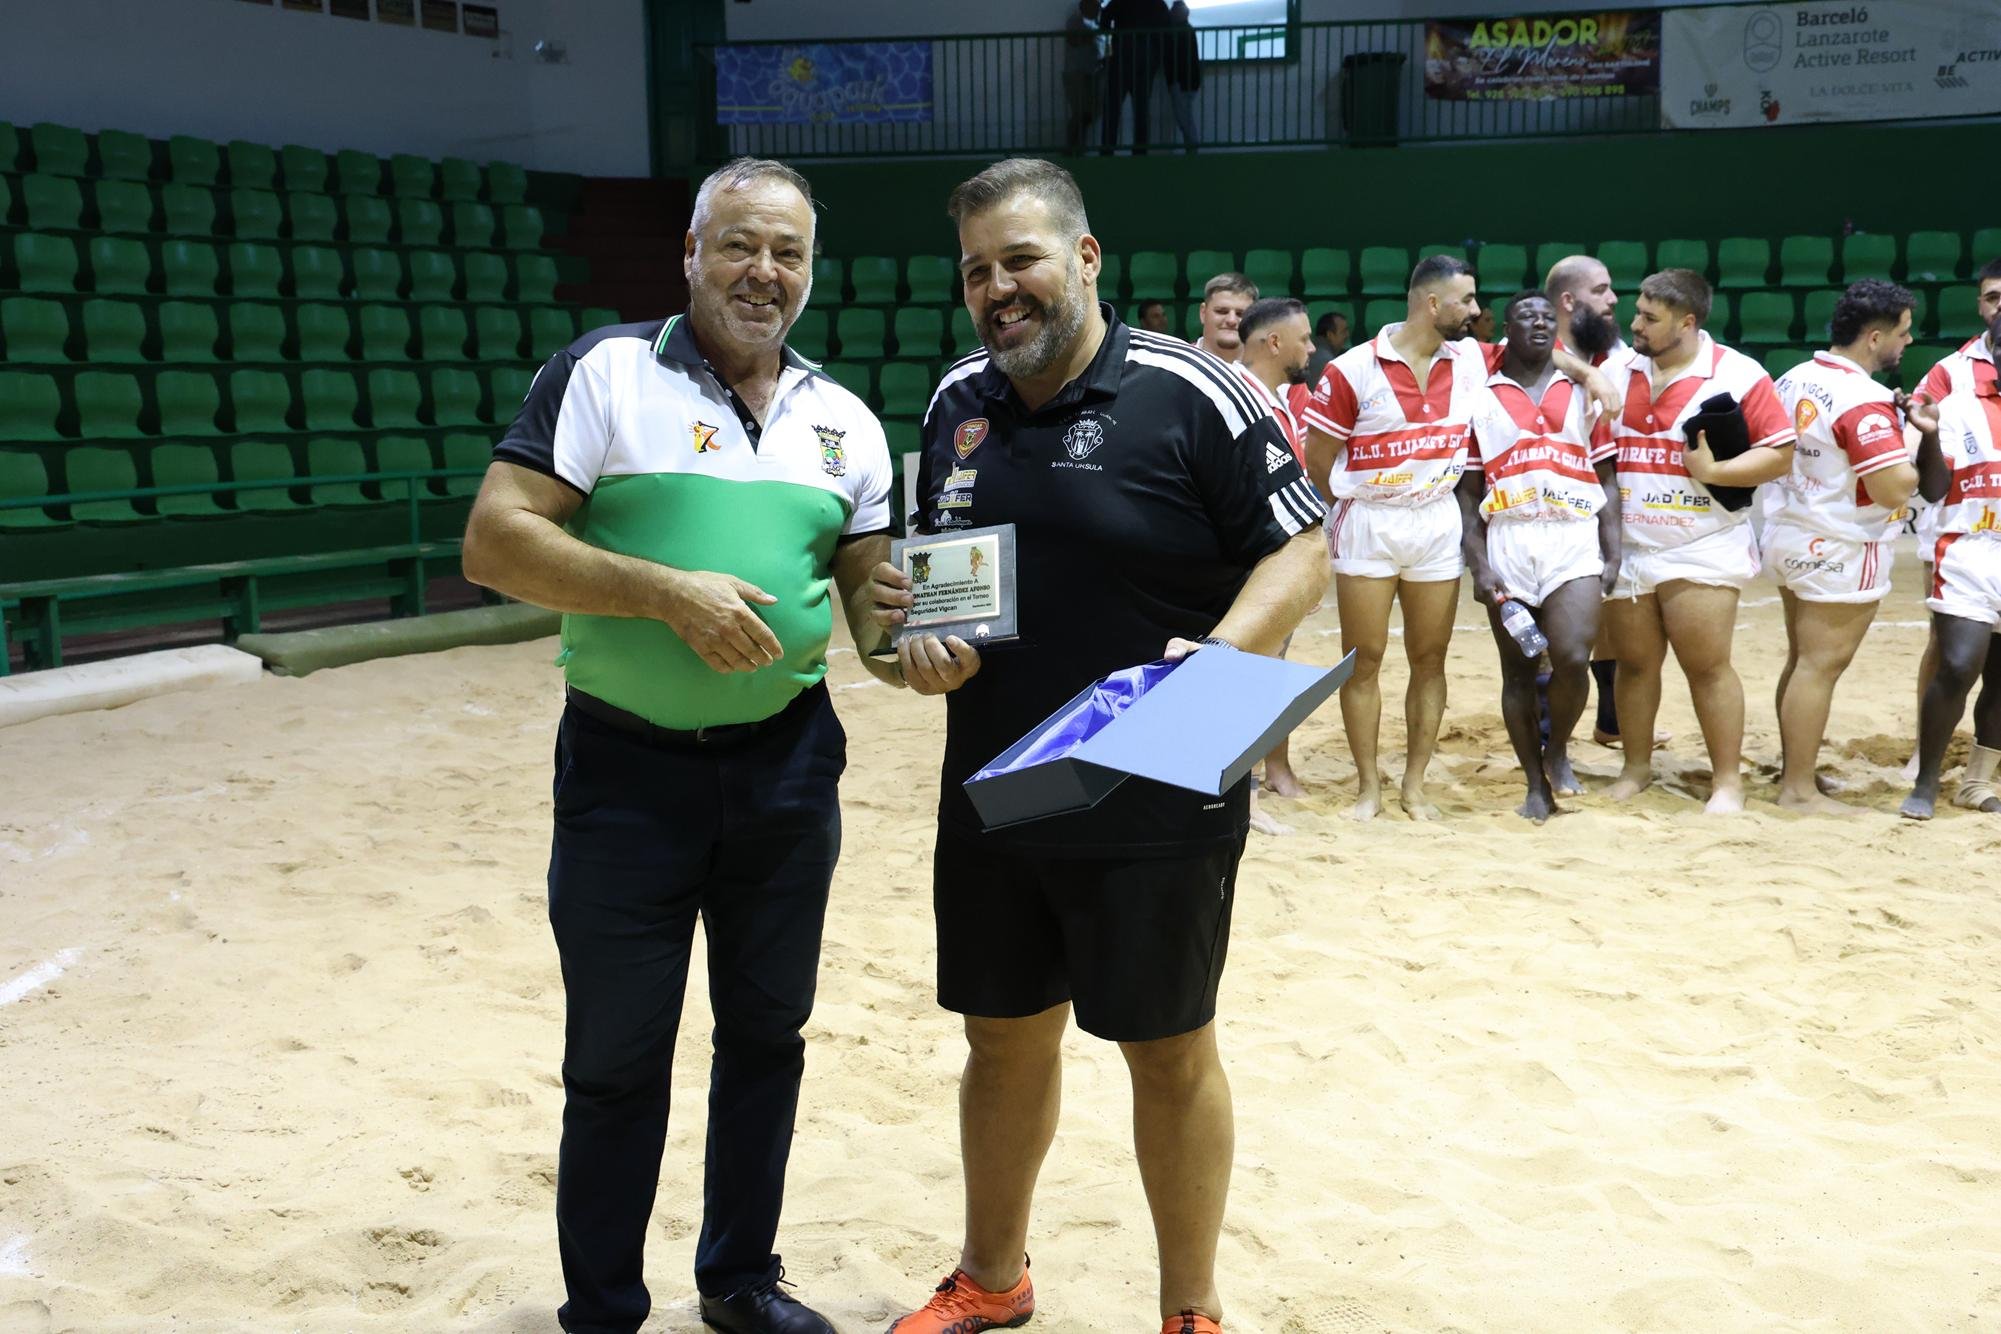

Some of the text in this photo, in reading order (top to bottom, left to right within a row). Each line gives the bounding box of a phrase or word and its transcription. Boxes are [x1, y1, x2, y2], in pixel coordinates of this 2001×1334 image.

[1797, 7, 1868, 26] Barceló
[1469, 18, 1598, 49] ASADOR
[1796, 30, 1889, 47] Lanzarote
[1794, 47, 1916, 69] Active Resort
[1937, 65, 1956, 76] BE
[1267, 453, 1293, 474] adidas
[931, 579, 973, 590] Agradecimiento
[912, 591, 938, 599] ONATHAN
